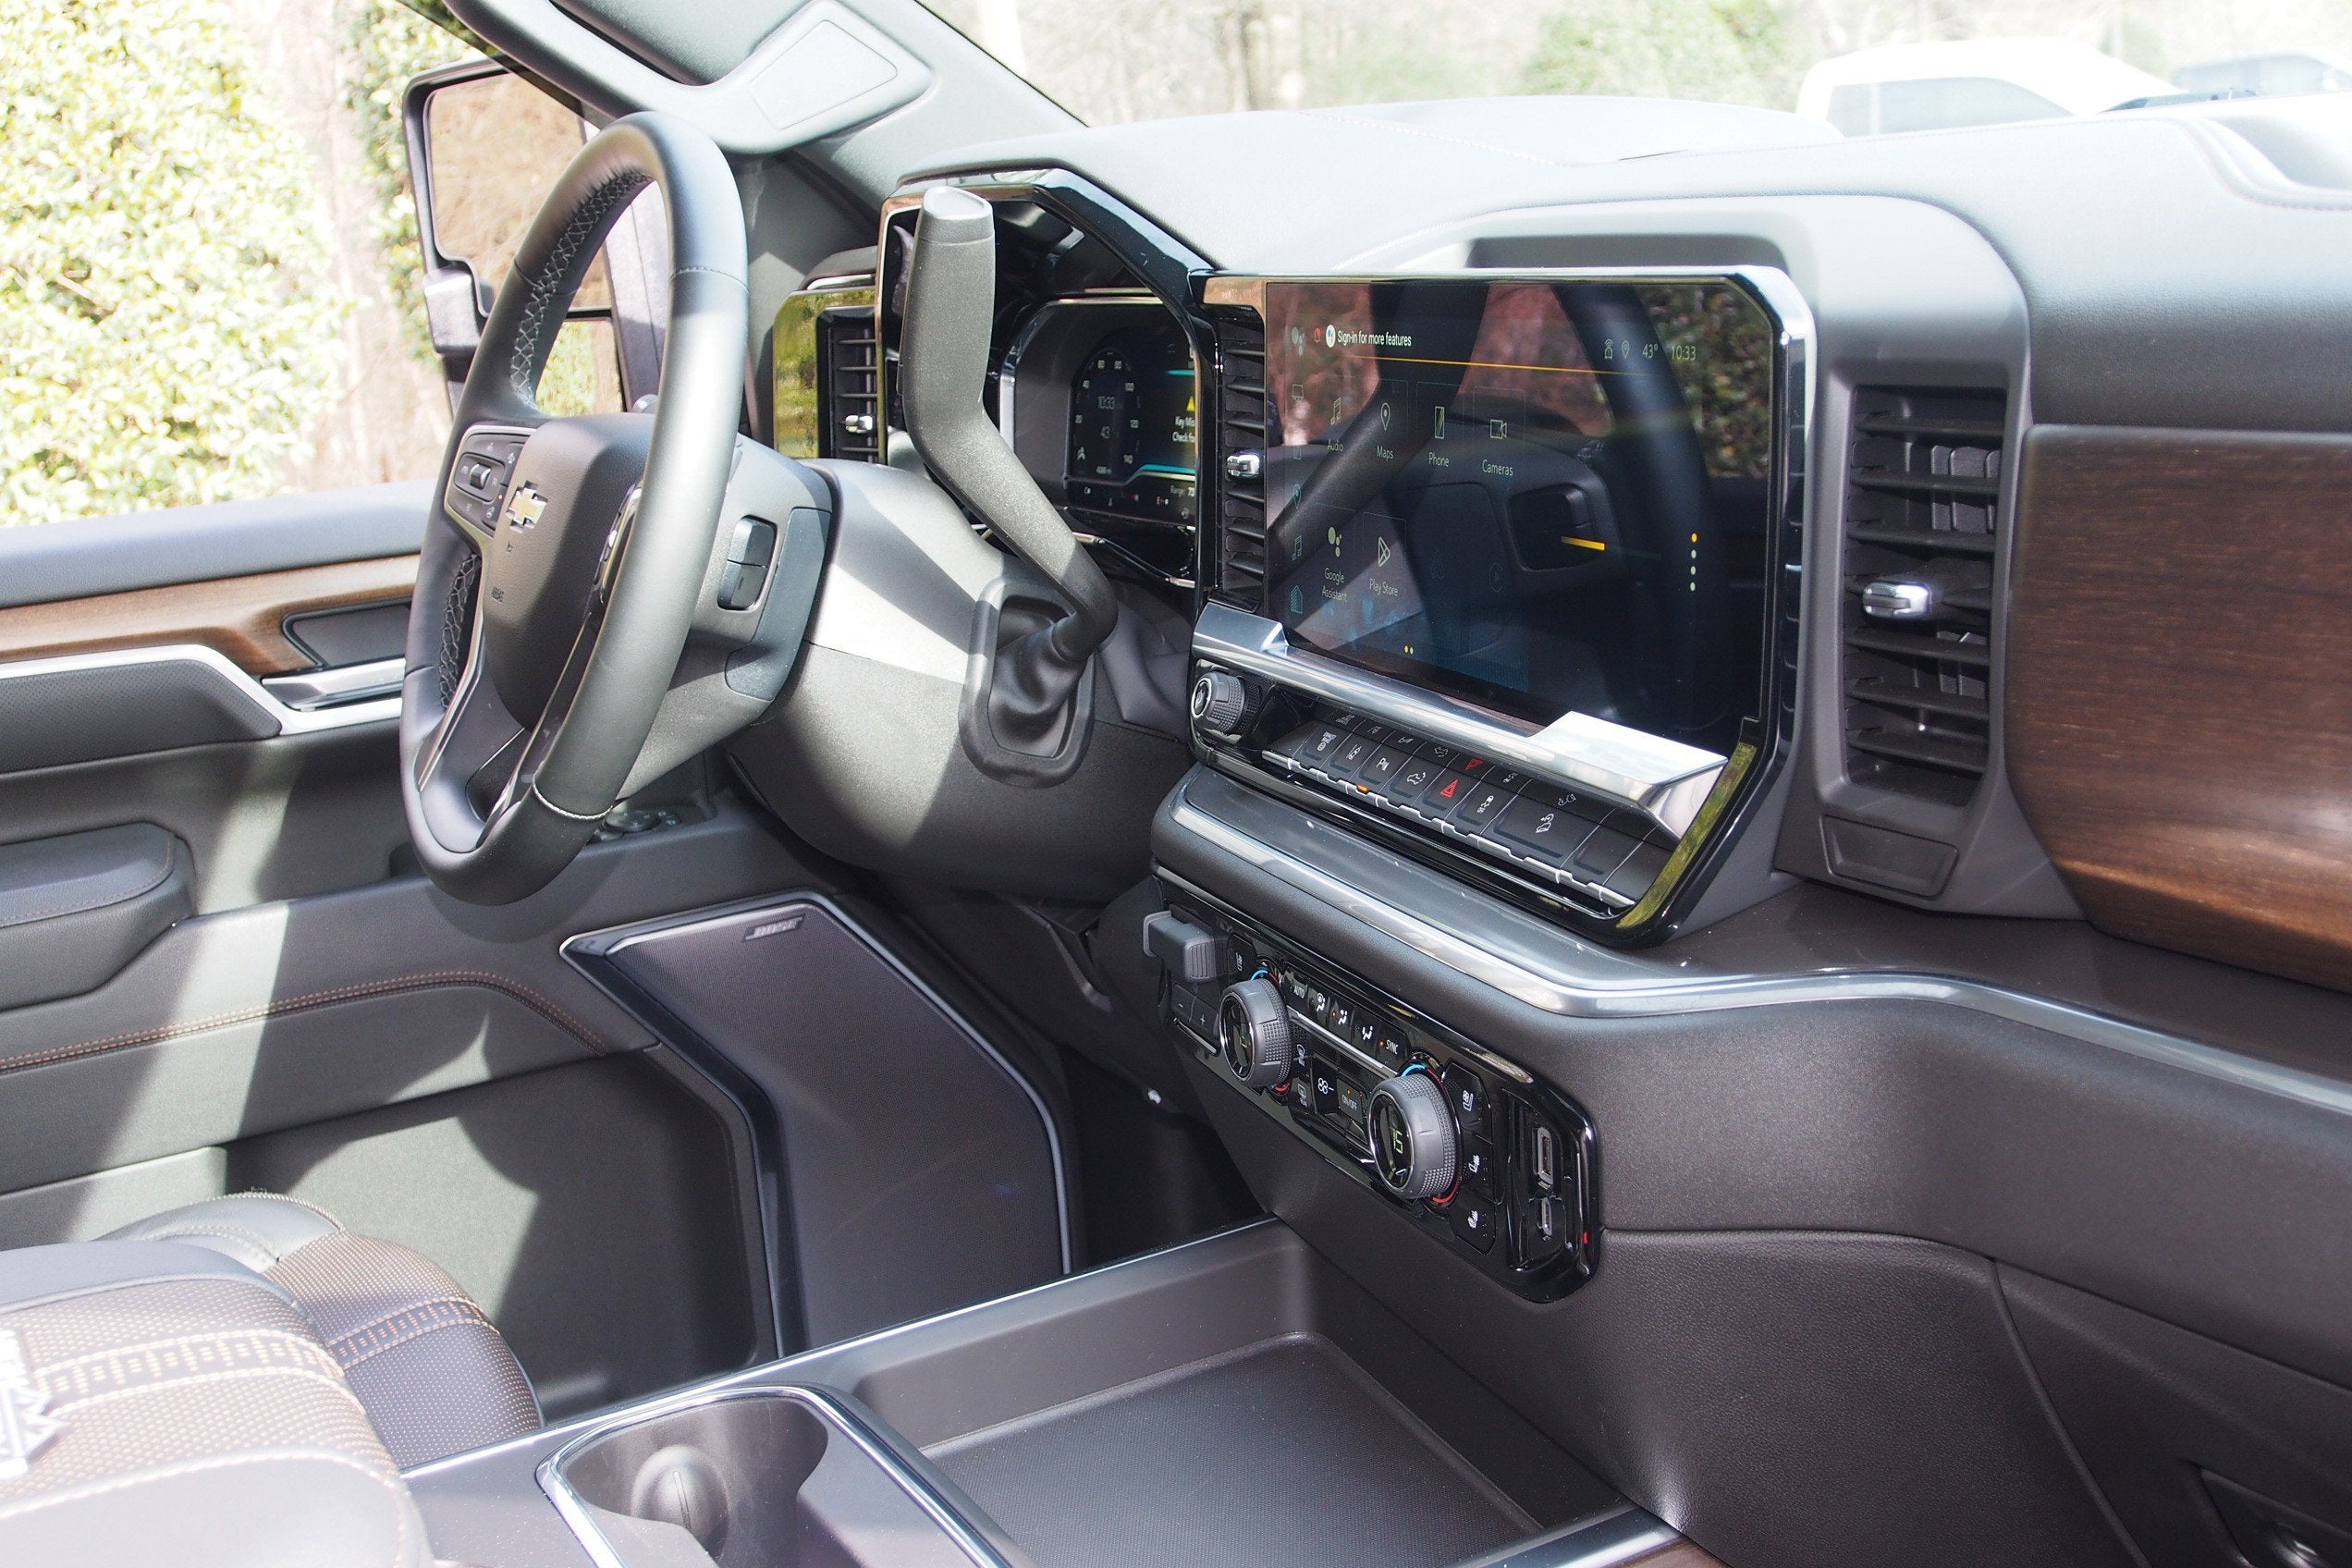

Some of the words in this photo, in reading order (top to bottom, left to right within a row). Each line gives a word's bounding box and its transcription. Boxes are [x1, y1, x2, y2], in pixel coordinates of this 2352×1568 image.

[1337, 330, 1358, 347] Sign-in
[1358, 331, 1367, 341] for
[1367, 334, 1385, 346] more
[1385, 331, 1412, 348] features
[1671, 345, 1697, 361] 10:33
[1327, 438, 1344, 453] Audio
[1377, 445, 1394, 461] Maps
[1428, 452, 1450, 468] Phone
[1482, 459, 1514, 476] Cameras
[1324, 567, 1345, 585] Google
[1321, 584, 1348, 603] Assistant
[1369, 578, 1382, 595] Play
[1382, 581, 1399, 596] Store
[1293, 985, 1305, 998] AUTO
[1385, 1039, 1400, 1054] SYNC
[1341, 1094, 1357, 1111] ON/OFF
